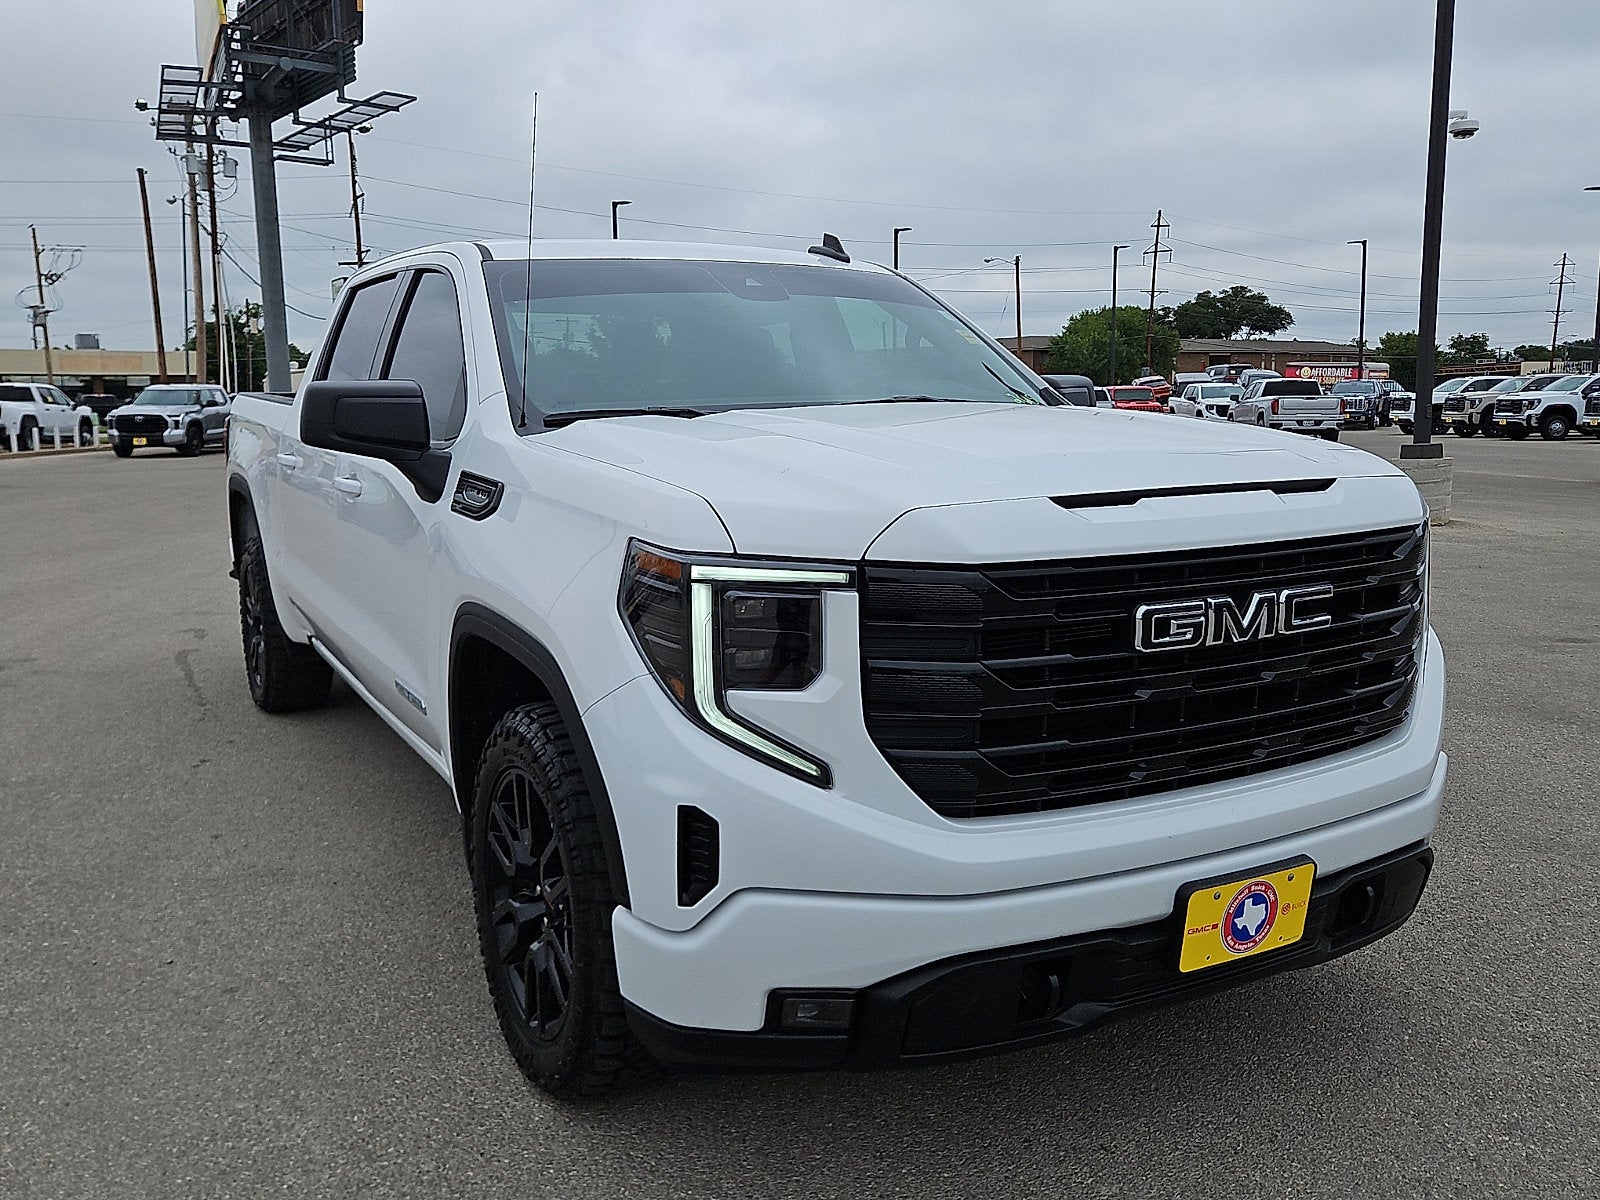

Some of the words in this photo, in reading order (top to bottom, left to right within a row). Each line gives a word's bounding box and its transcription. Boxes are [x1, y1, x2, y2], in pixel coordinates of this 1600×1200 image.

[1311, 368, 1353, 377] AFFORDABLE
[1135, 584, 1334, 653] GMC
[1187, 925, 1211, 935] GMC
[1255, 924, 1270, 942] Texas
